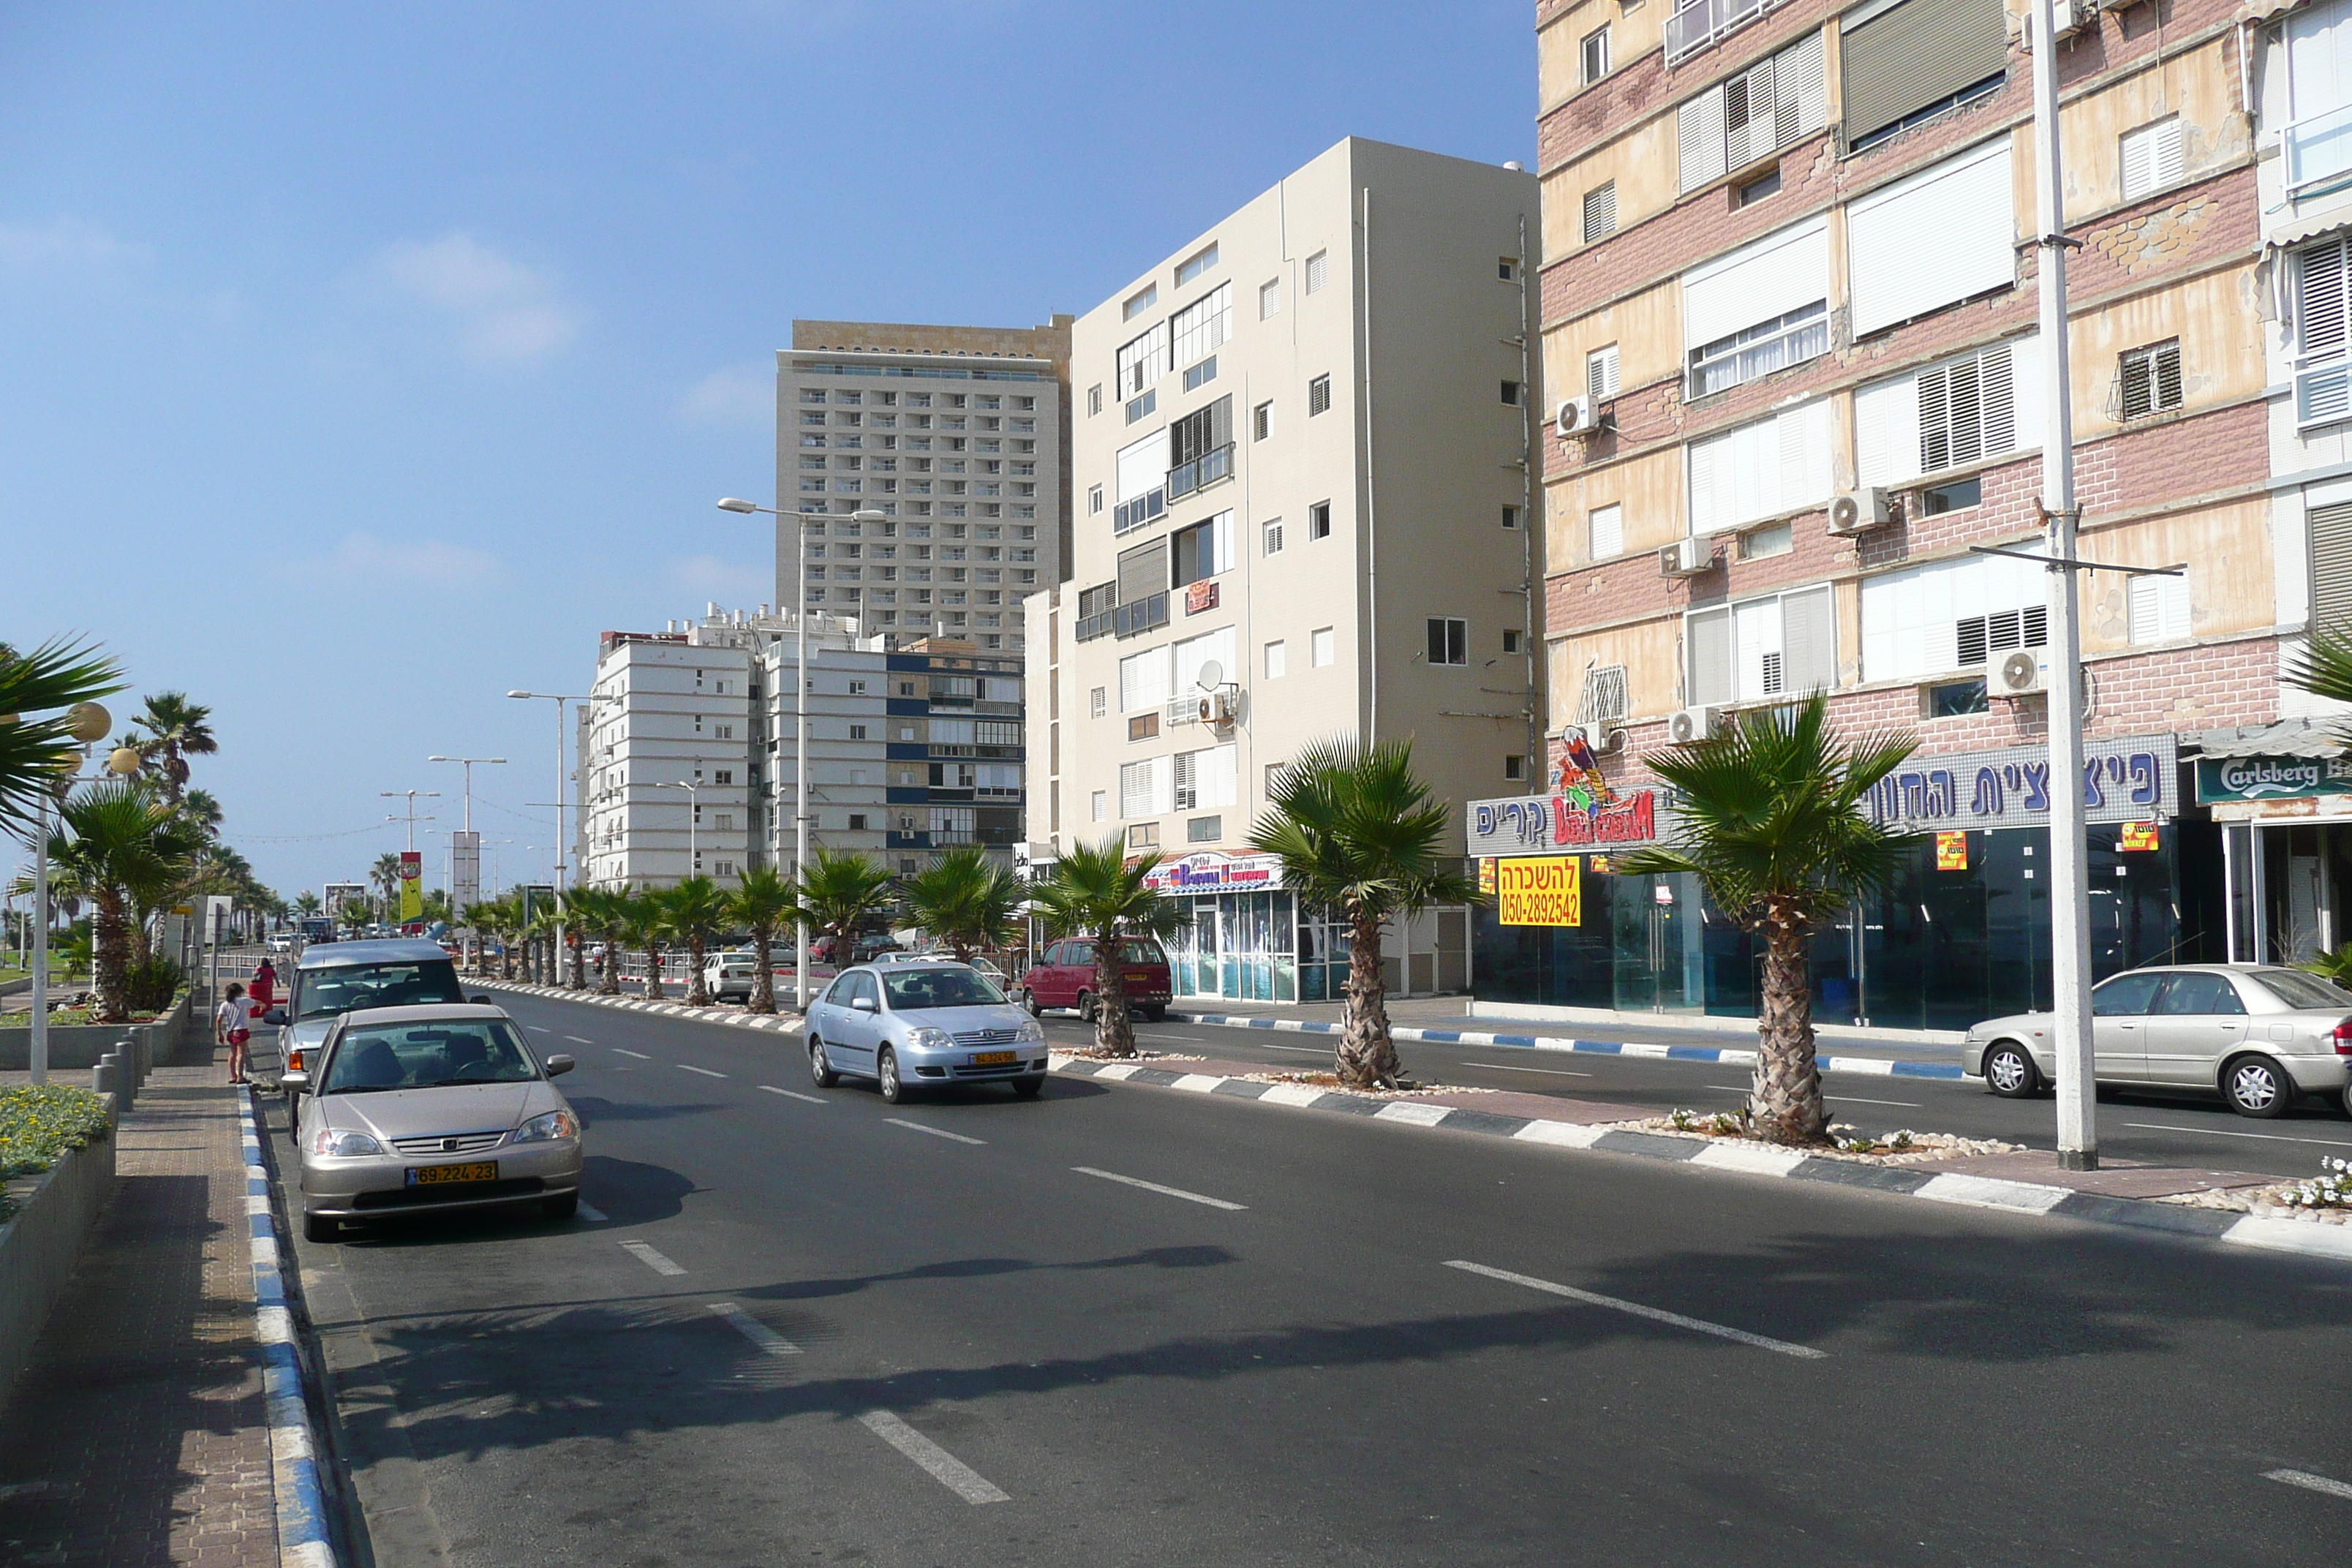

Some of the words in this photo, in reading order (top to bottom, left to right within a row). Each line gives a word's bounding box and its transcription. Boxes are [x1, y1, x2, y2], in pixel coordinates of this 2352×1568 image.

[2220, 758, 2320, 791] Carlsberg
[1502, 859, 1575, 890] להשכרה
[1501, 893, 1578, 924] 050-2892542
